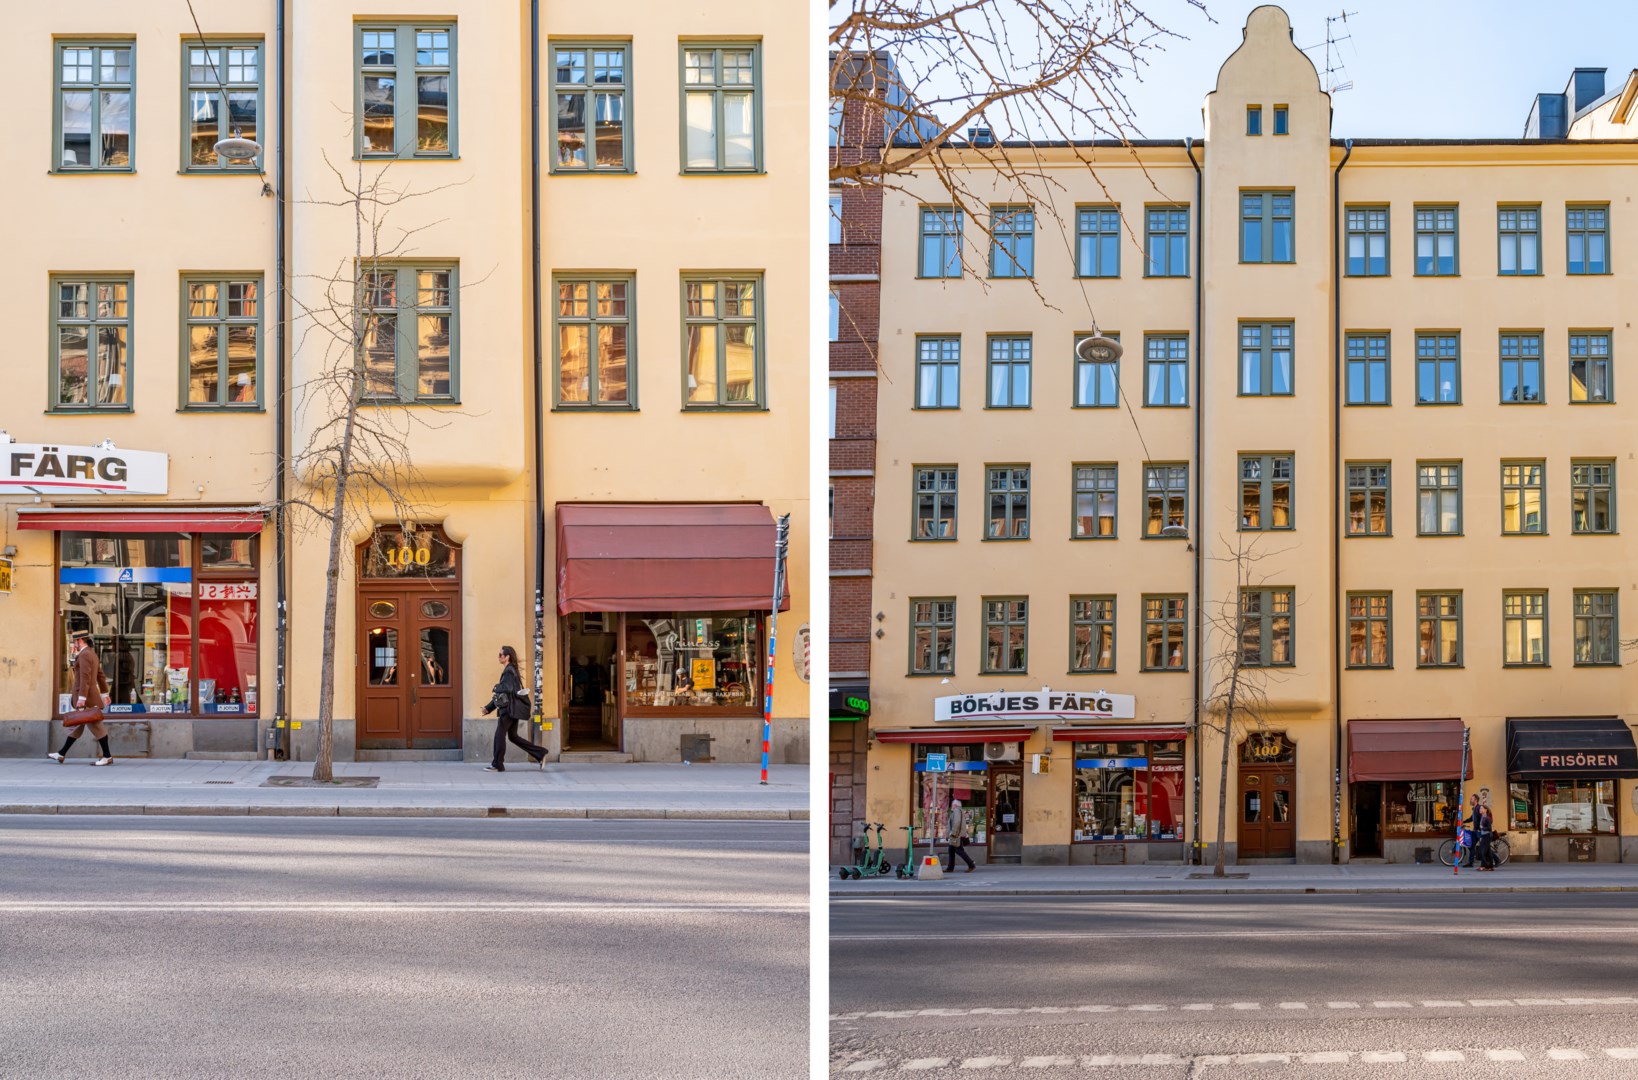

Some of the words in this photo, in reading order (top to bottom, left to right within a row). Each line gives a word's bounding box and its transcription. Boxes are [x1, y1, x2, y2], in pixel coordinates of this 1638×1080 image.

[11, 446, 127, 482] FÄRG
[386, 546, 430, 566] 100
[665, 632, 720, 652] Princess
[848, 697, 869, 713] coop
[951, 695, 1039, 714] BÖRJES
[1049, 693, 1113, 712] FÄRG
[1254, 745, 1280, 757] 100
[1540, 752, 1618, 767] FRISÖREN
